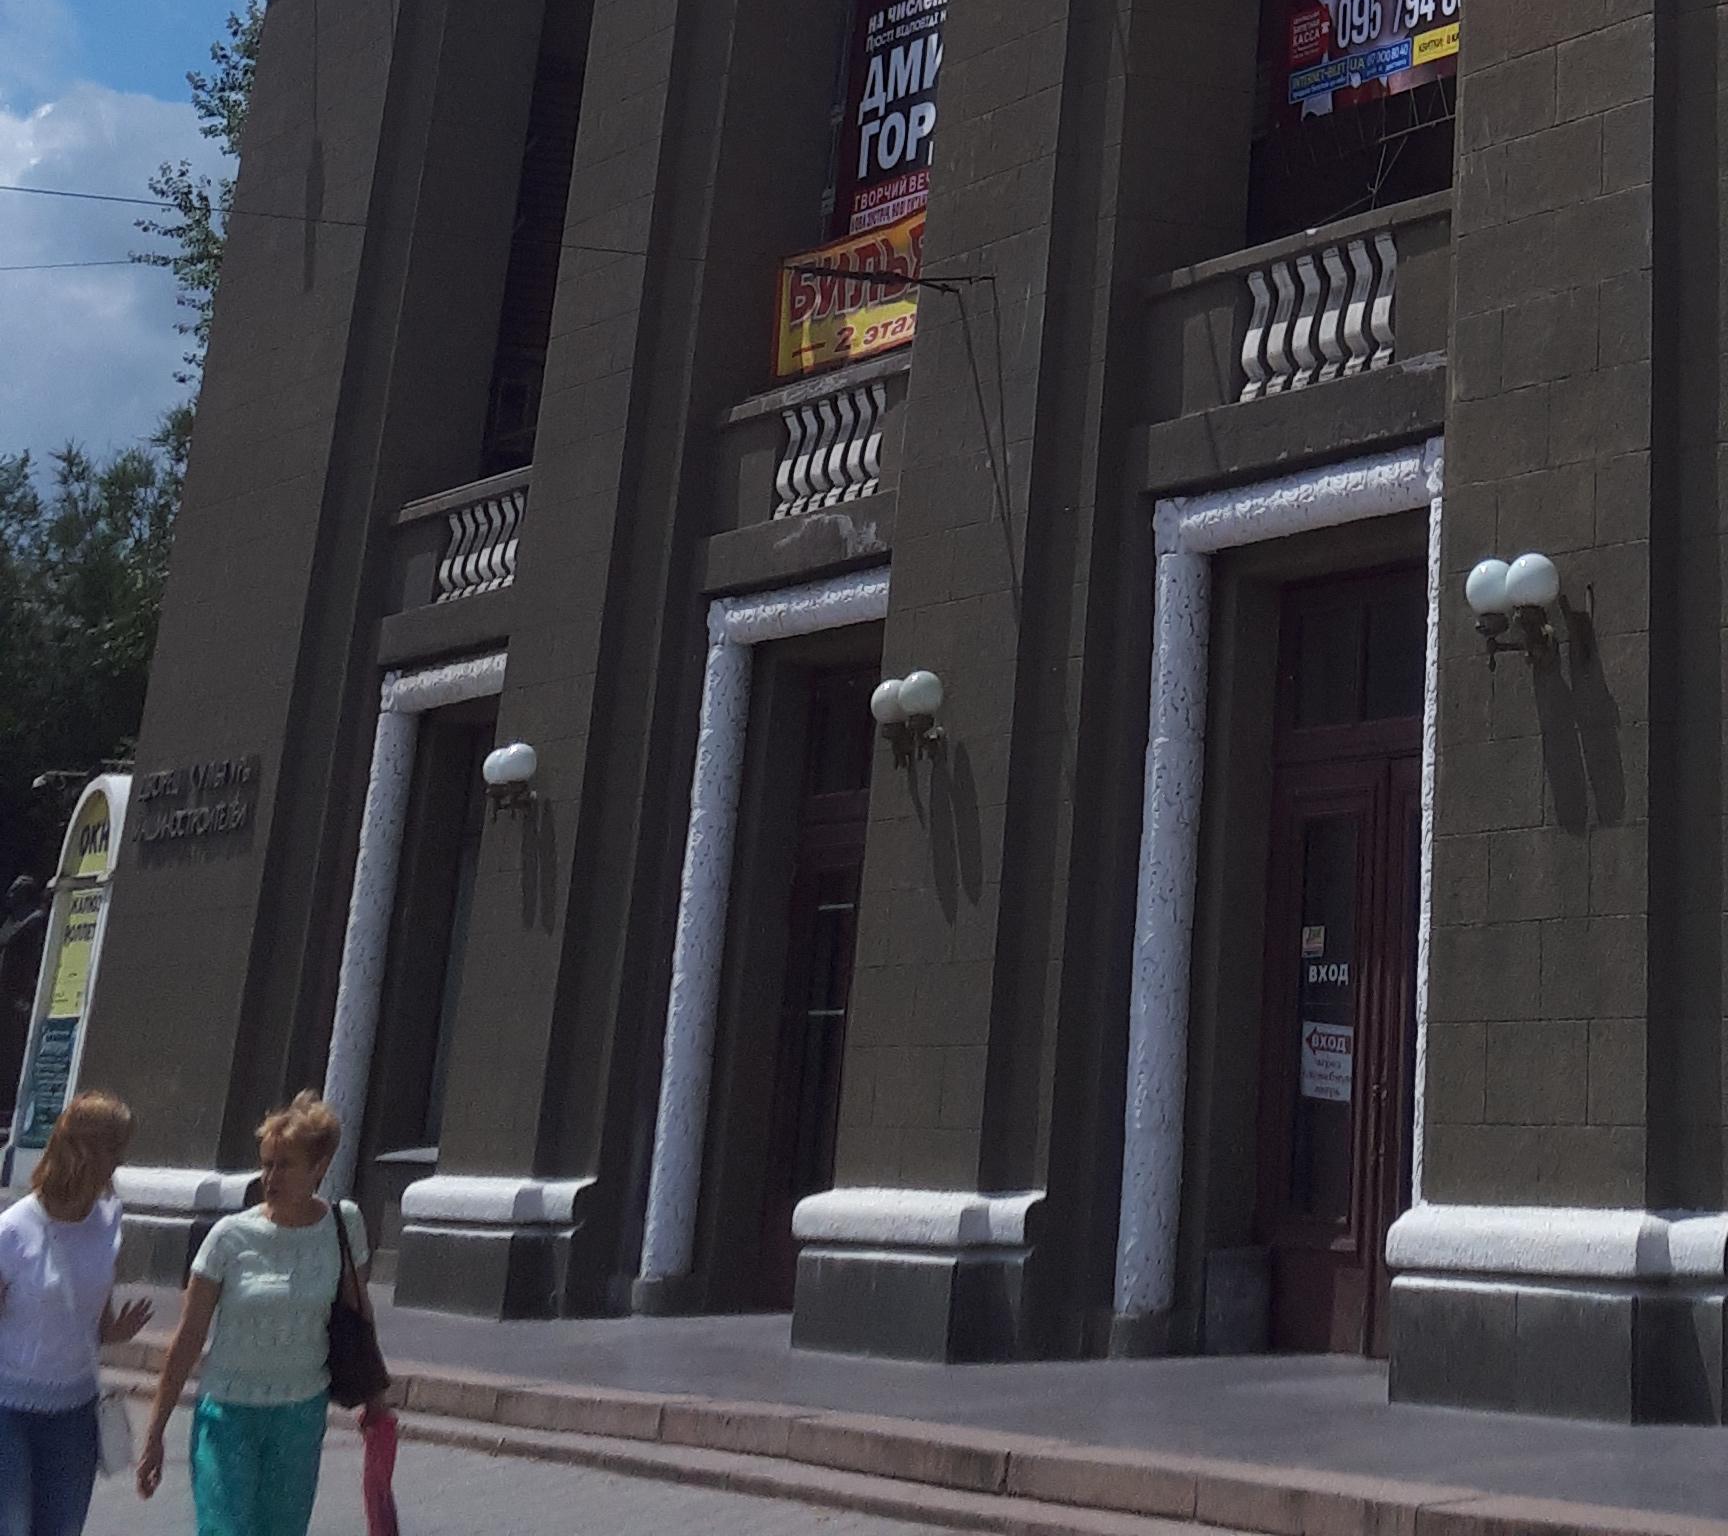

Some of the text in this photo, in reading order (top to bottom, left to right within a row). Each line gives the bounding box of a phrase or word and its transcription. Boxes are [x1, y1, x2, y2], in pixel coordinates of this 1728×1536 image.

[857, 101, 938, 180] ГОР
[834, 324, 855, 353] 2
[1308, 963, 1349, 987] ВХОД
[1311, 1033, 1347, 1053] ВХОД
